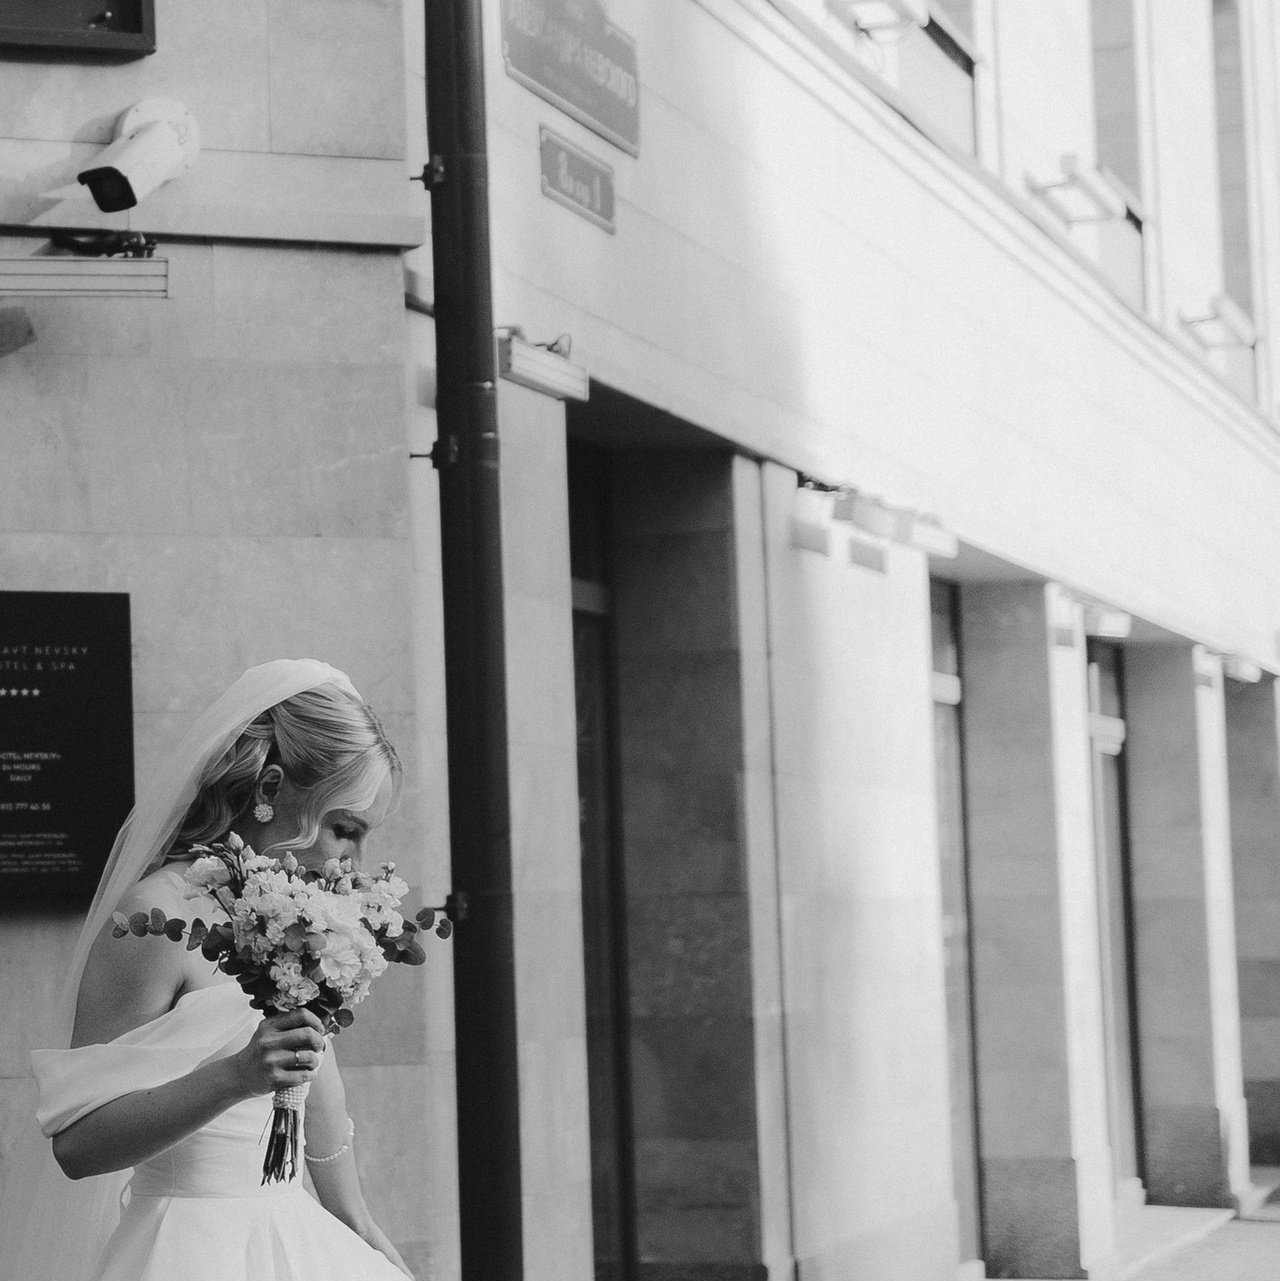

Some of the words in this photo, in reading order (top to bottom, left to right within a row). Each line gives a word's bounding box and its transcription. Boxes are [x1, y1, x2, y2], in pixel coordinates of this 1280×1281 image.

[34, 646, 89, 656] NEVSKY
[36, 661, 44, 671] &
[51, 661, 77, 671] SPA
[13, 763, 42, 771] HOURS
[9, 774, 33, 782] DAILY
